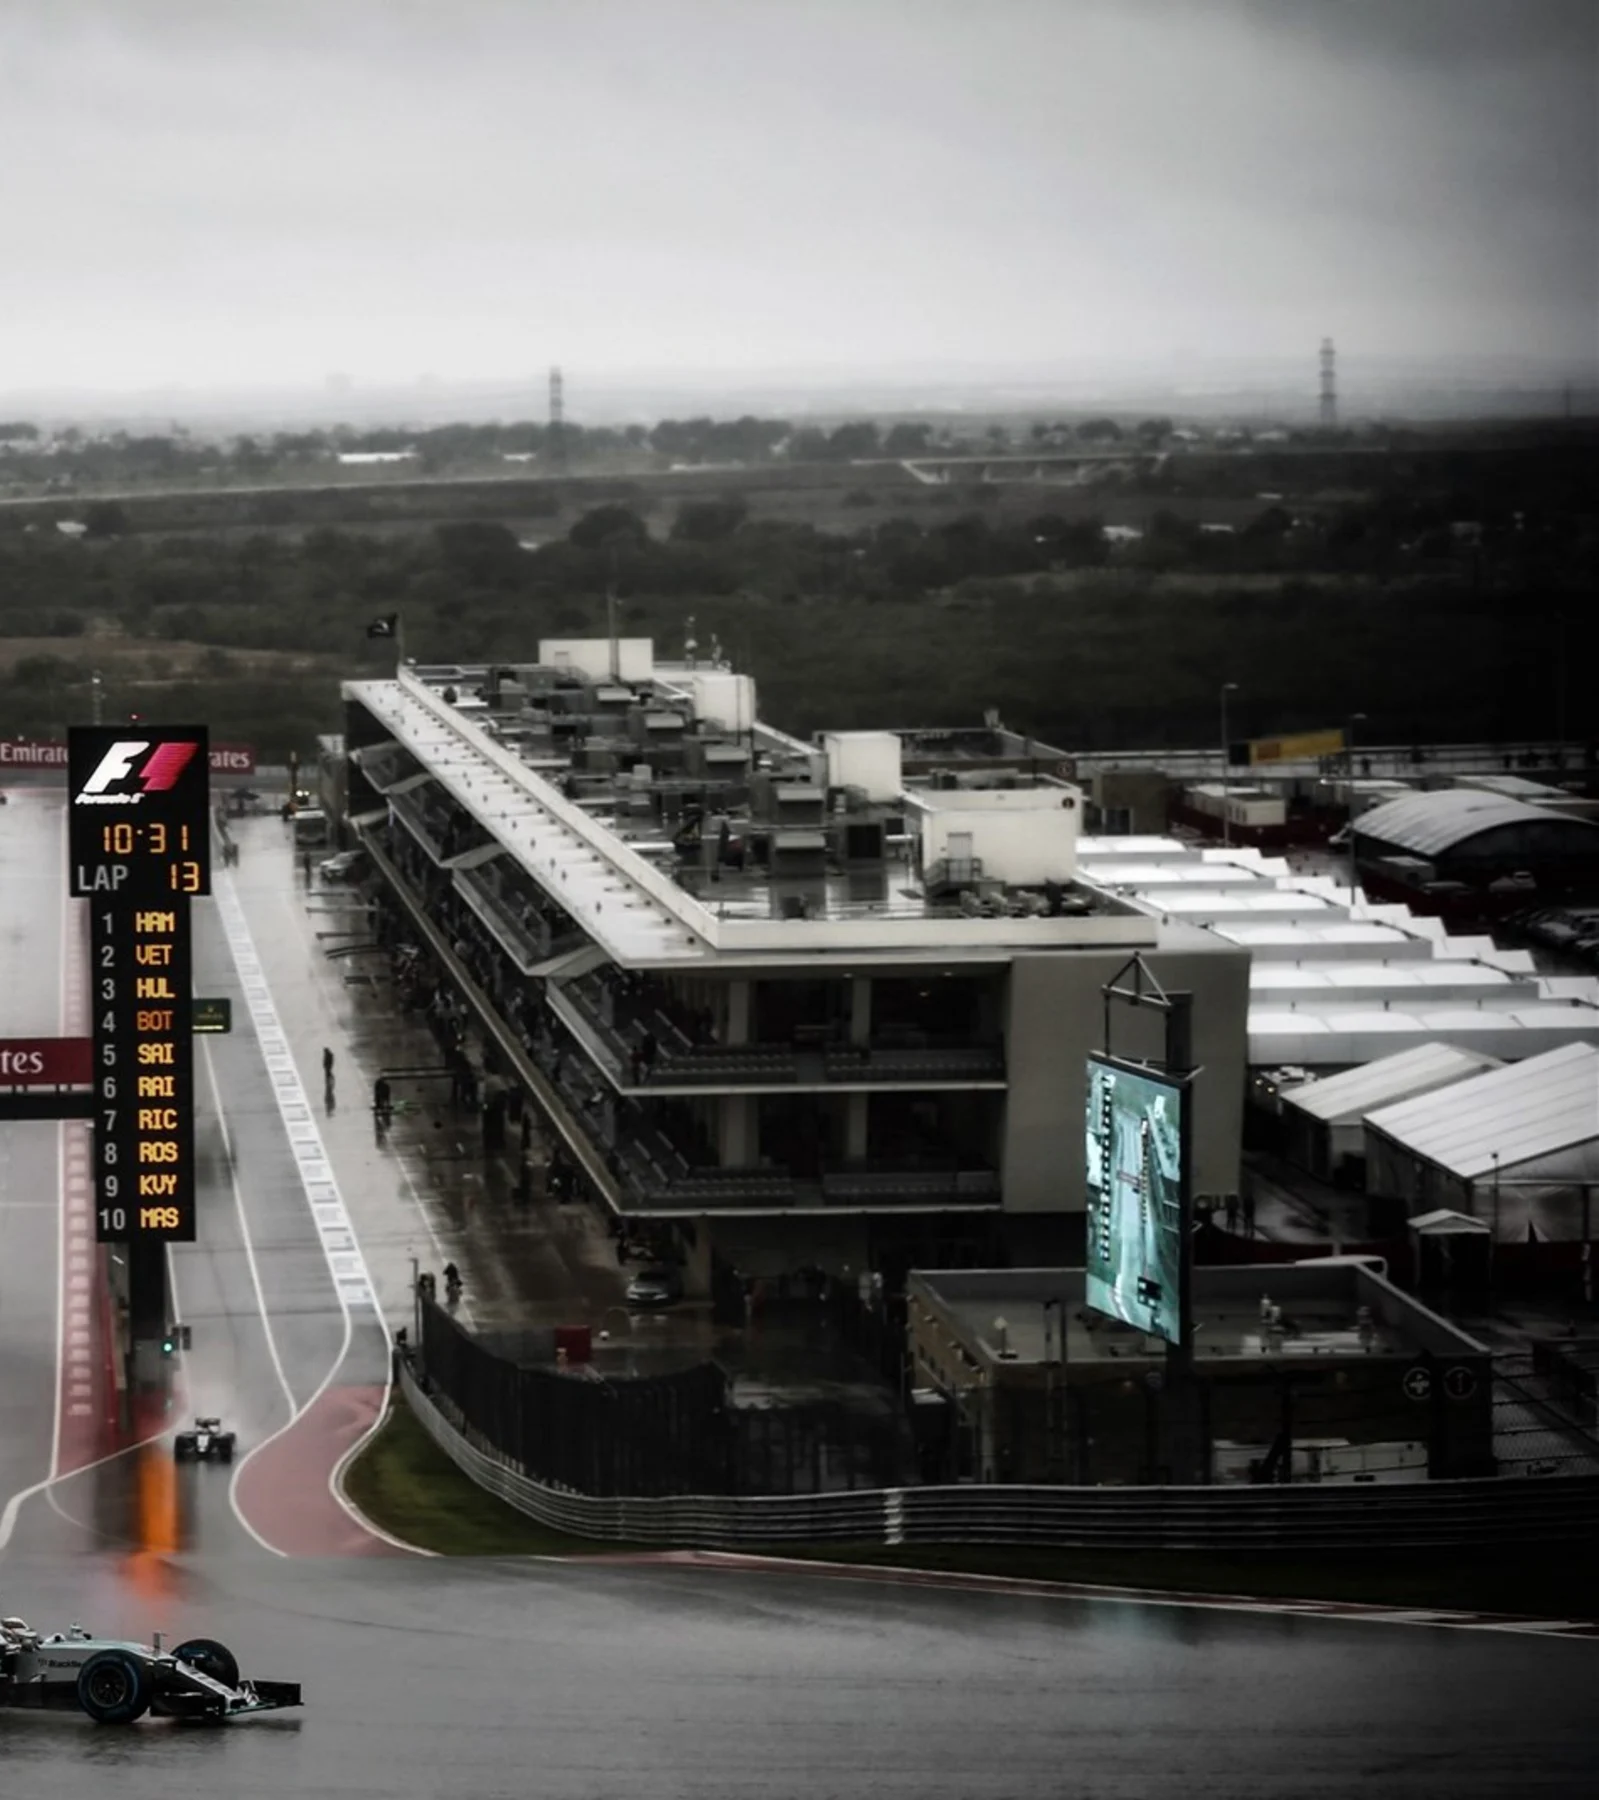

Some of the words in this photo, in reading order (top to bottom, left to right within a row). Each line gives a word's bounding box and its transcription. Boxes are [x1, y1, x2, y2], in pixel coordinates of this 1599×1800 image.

[78, 865, 128, 890] LAP
[171, 862, 199, 891] 13
[102, 912, 112, 934] 1
[136, 912, 175, 932] HAM
[101, 945, 115, 967] 2
[136, 944, 172, 965] VET
[102, 978, 115, 1000] 3
[137, 978, 175, 998] HUL
[102, 1011, 115, 1032] 4
[137, 1010, 173, 1031] BOT
[103, 1044, 116, 1066] 5
[138, 1043, 174, 1064] SAI
[103, 1076, 116, 1098] 6
[138, 1076, 175, 1096] RAI
[104, 1110, 117, 1131] 7
[139, 1109, 177, 1129] RIC
[105, 1143, 117, 1164] 8
[140, 1142, 178, 1162] ROS
[105, 1175, 118, 1197] 9
[140, 1175, 177, 1195] KVY
[100, 1208, 126, 1230] 10
[140, 1207, 179, 1228] MAS
